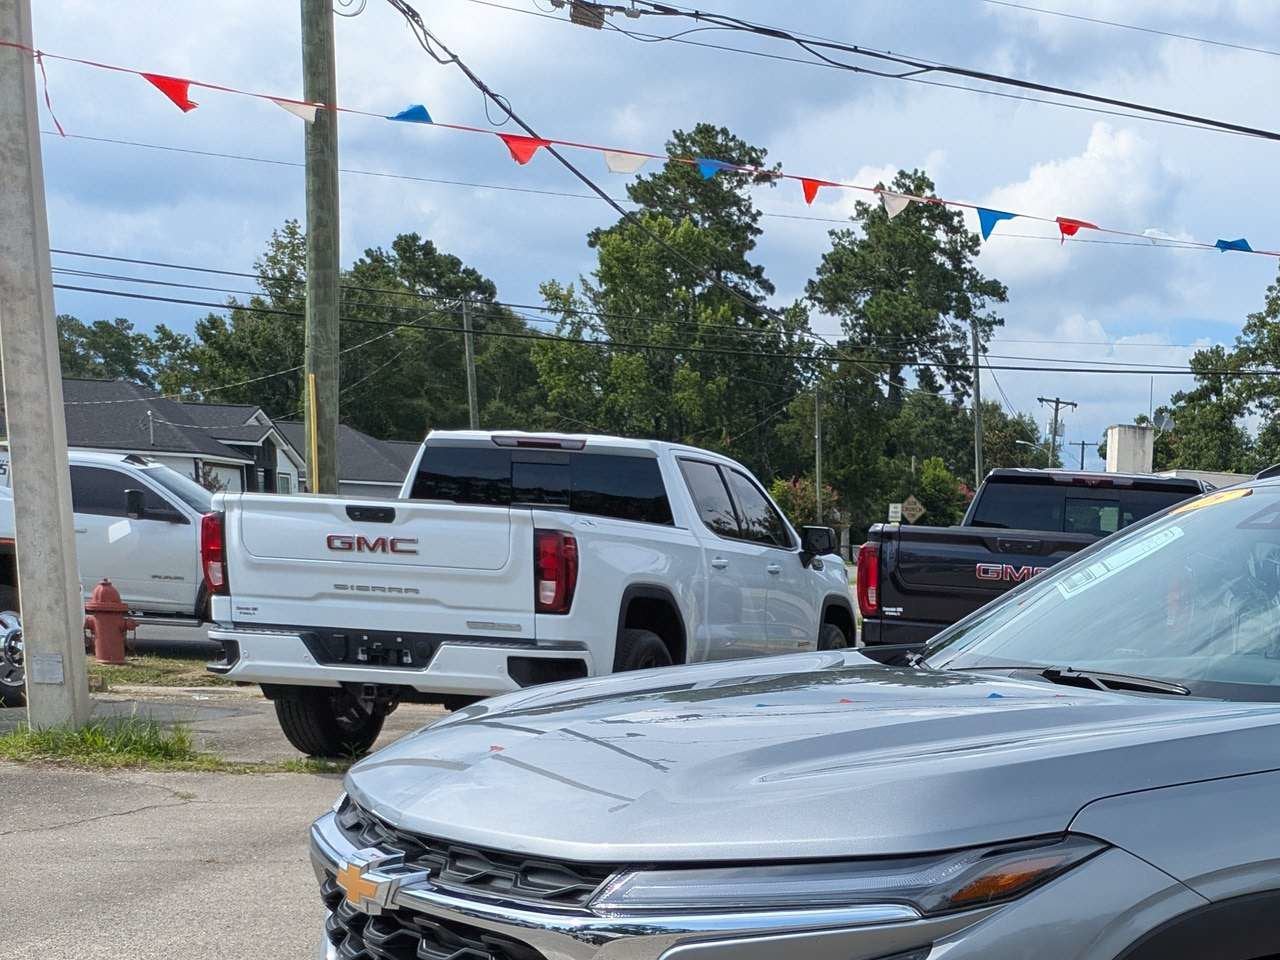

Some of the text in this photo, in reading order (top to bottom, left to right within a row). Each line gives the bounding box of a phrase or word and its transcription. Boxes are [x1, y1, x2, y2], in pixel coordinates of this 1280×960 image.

[326, 534, 419, 555] GMC
[976, 563, 1050, 582] GM
[333, 583, 420, 594] SIERRA
